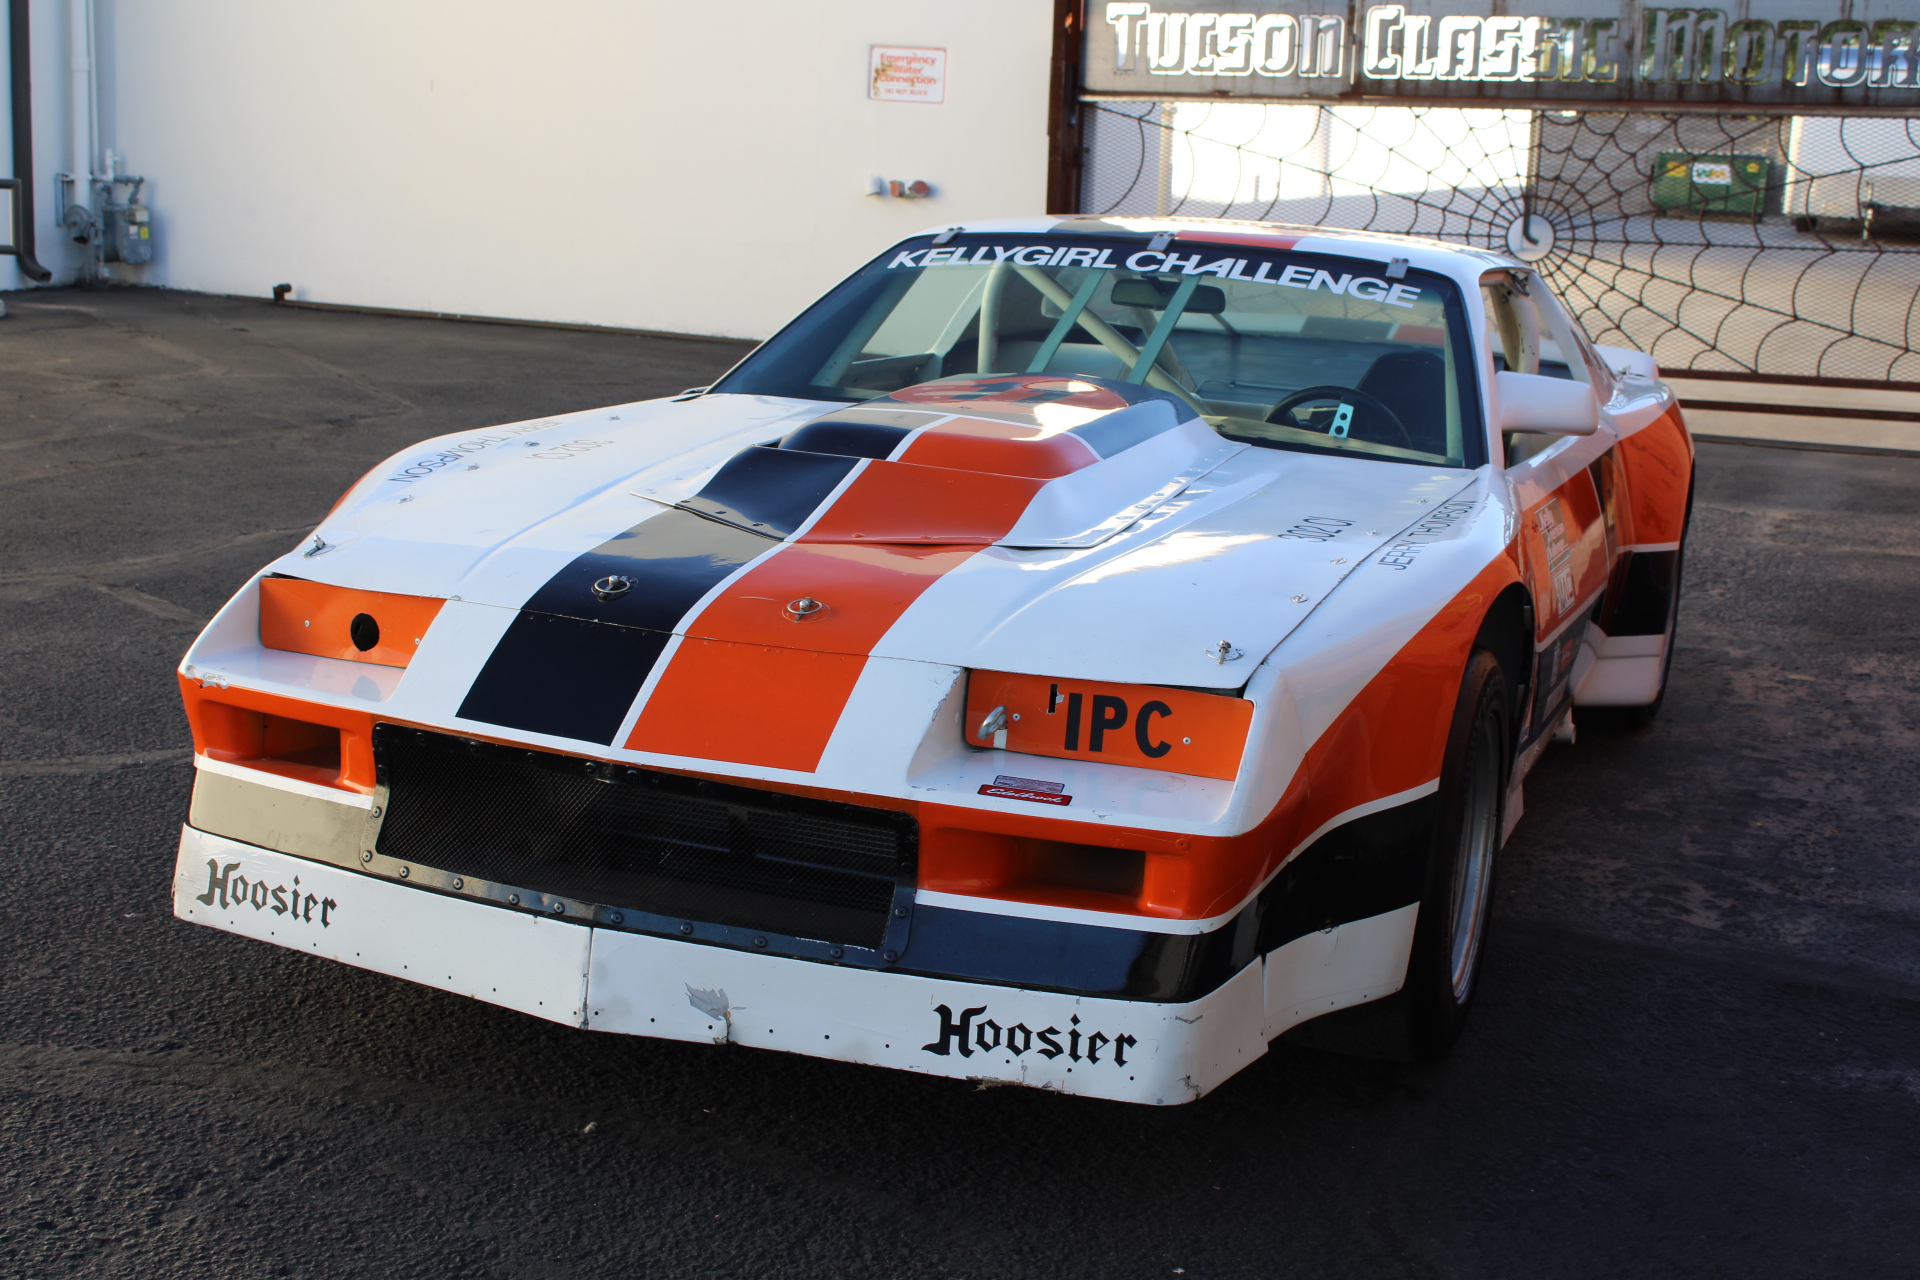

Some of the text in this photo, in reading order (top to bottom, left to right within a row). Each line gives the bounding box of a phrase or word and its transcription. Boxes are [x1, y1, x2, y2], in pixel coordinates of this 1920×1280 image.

[880, 53, 936, 66] Emergency
[893, 65, 924, 74] Water
[887, 246, 1422, 308] KELLYGIRL CHALLENGE
[388, 435, 511, 483] THOMPSON
[1377, 500, 1479, 571] JERRY THOMPSON
[1064, 692, 1173, 758] IPC
[196, 858, 337, 929] Hoosier
[921, 1003, 1138, 1068] Hoosier
